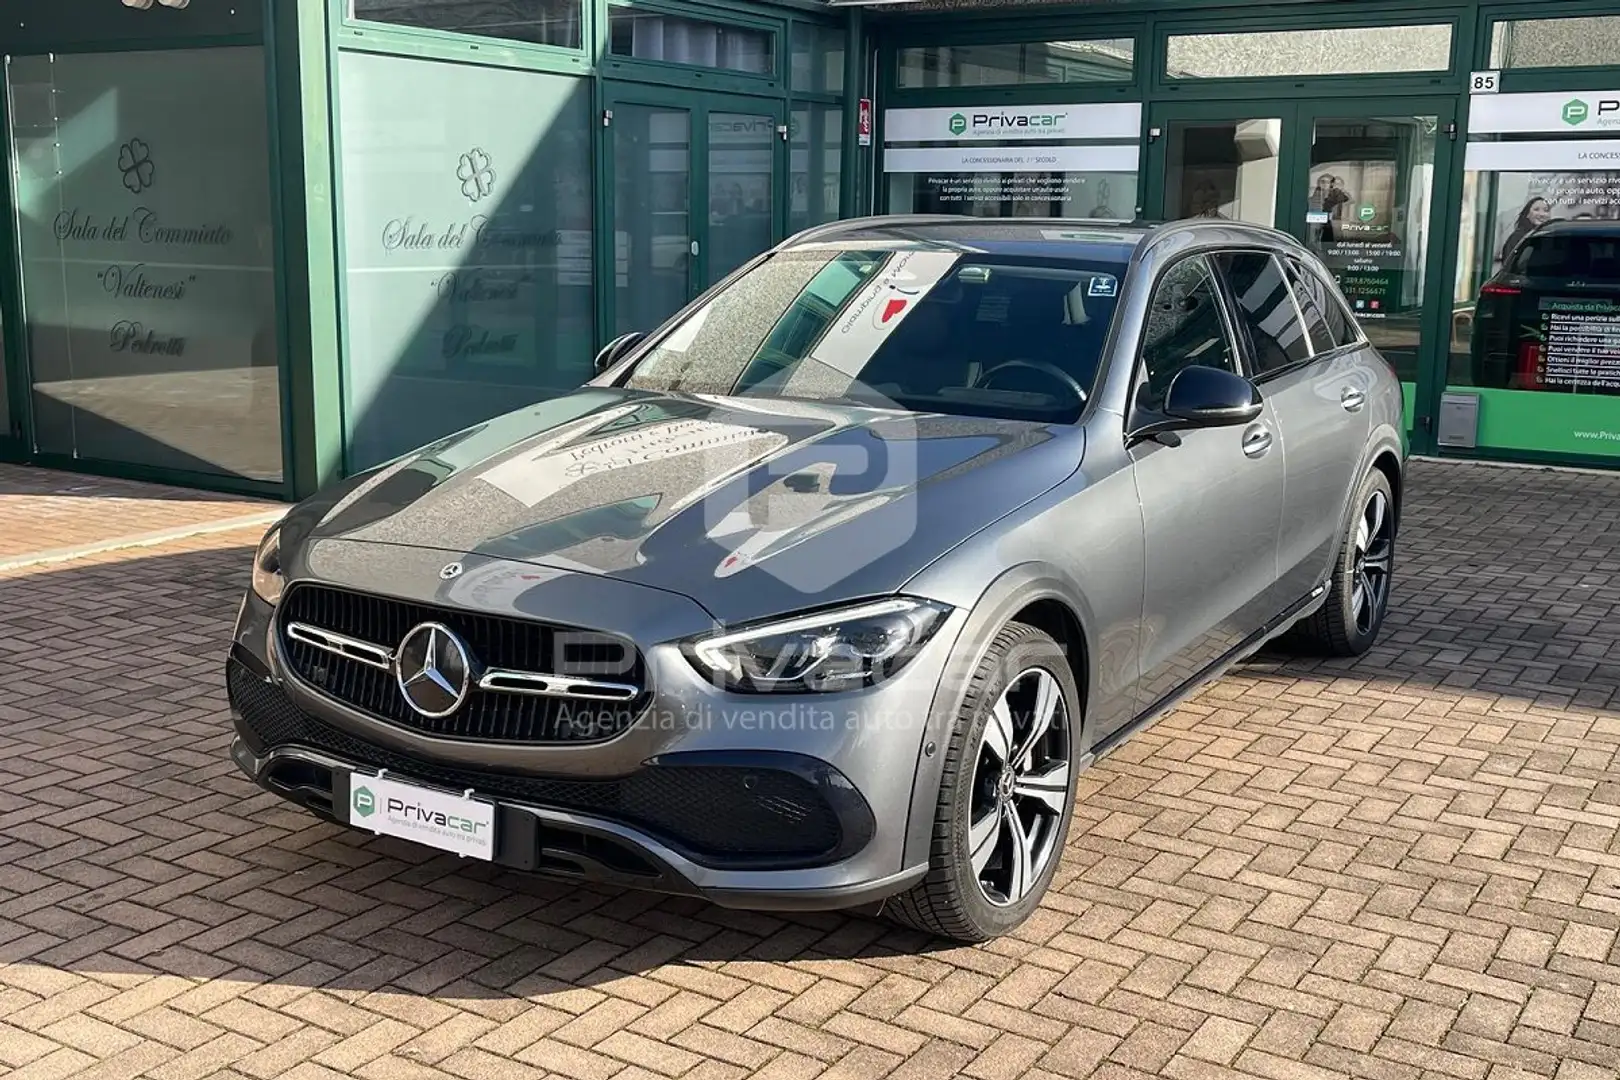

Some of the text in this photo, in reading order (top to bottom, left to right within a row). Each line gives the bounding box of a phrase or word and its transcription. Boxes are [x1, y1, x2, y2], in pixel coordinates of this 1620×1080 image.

[1474, 77, 1494, 89] 85
[973, 111, 1066, 127] Privacar
[53, 207, 234, 245] Sala del Commiato
[382, 216, 433, 251] Sala
[437, 221, 468, 250] del
[387, 798, 487, 834] Privacar
